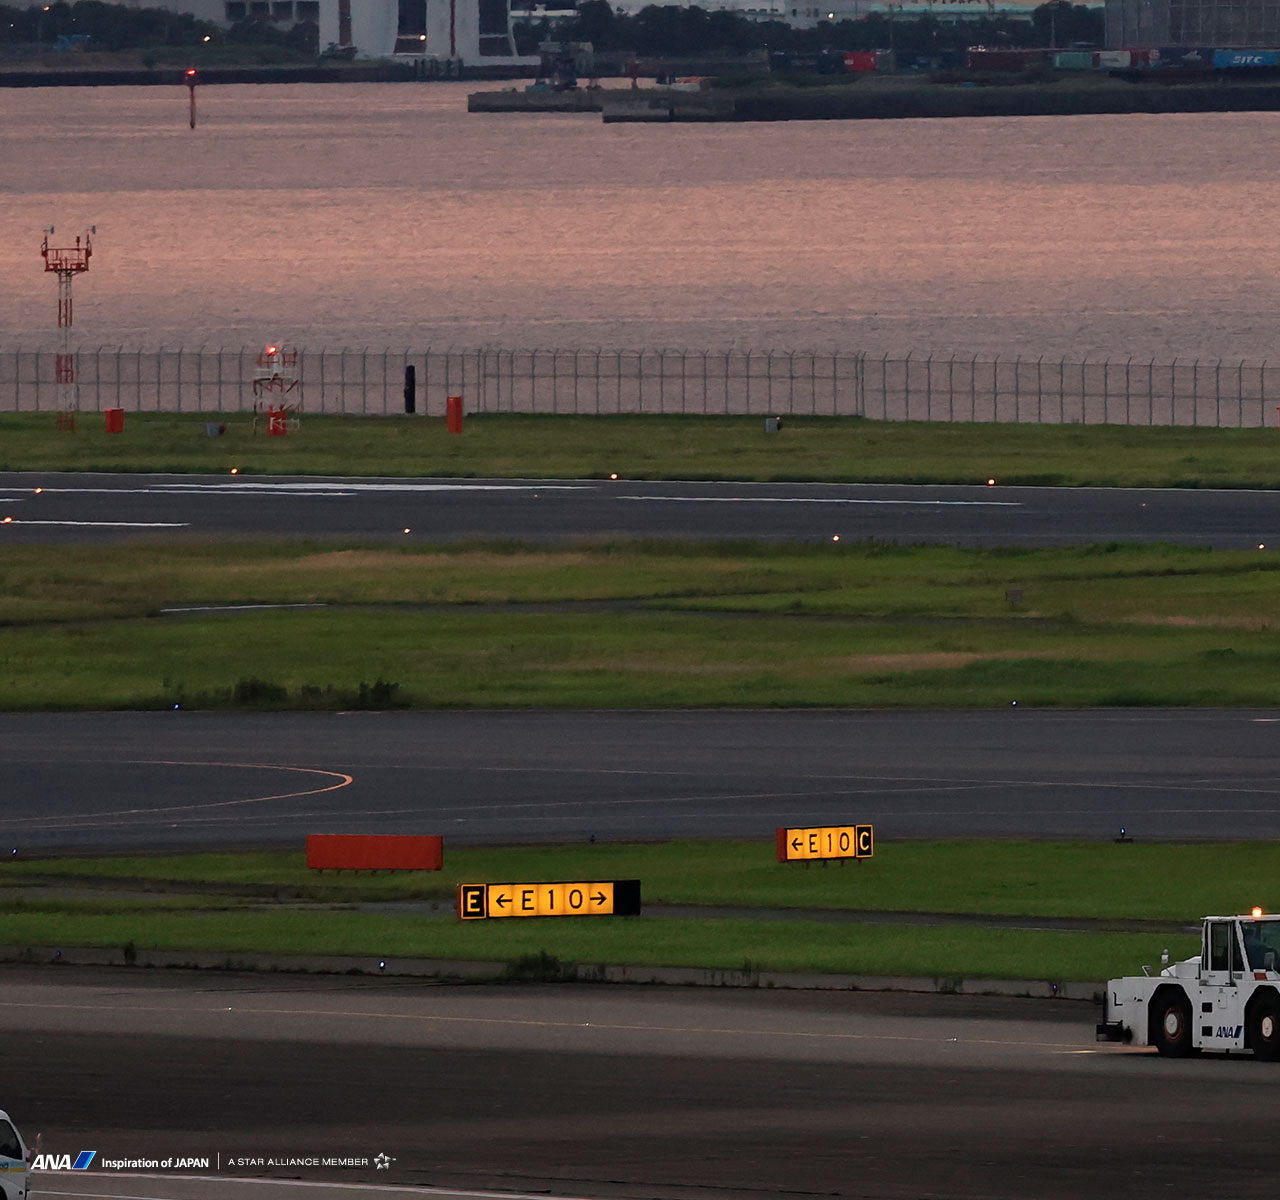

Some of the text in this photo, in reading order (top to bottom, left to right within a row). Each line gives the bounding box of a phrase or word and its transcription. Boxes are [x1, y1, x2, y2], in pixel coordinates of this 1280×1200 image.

[808, 831, 870, 853] E10 C
[466, 889, 583, 912] E E10
[1216, 1025, 1234, 1038] ANA
